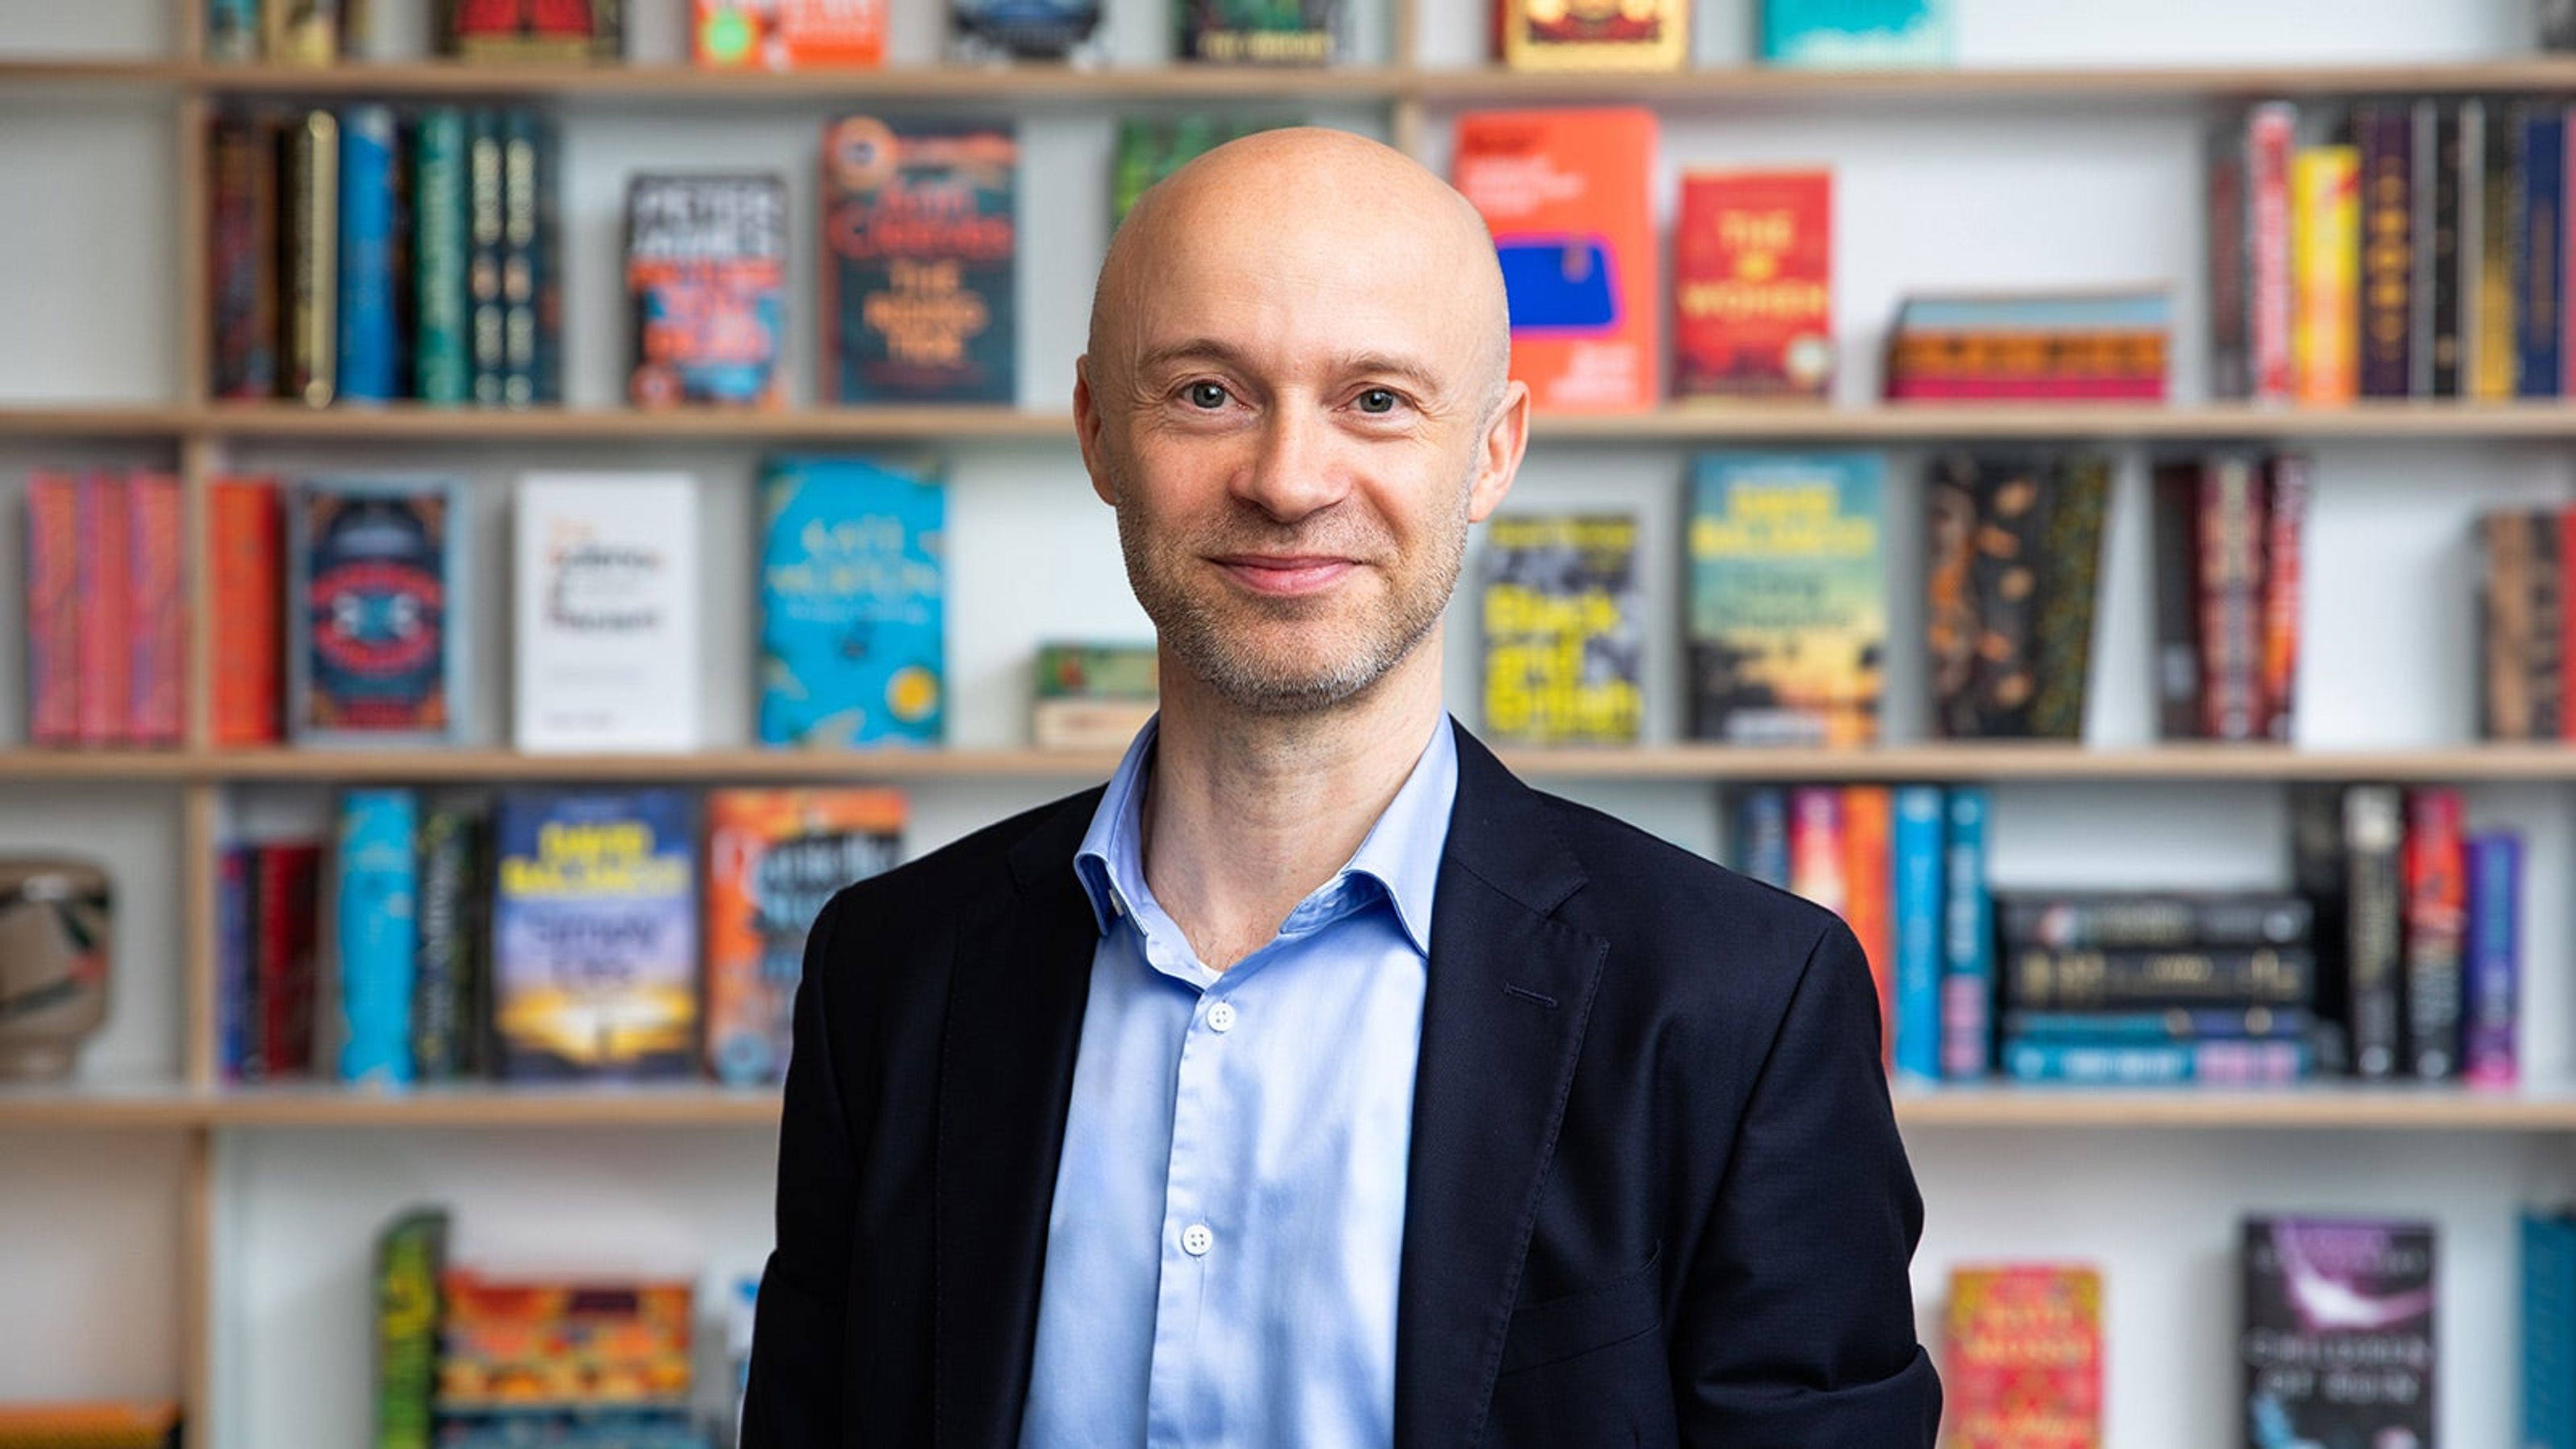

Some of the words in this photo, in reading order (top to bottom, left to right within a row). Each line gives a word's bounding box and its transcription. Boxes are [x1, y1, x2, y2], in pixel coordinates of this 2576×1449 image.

[636, 181, 782, 216] PETER
[633, 219, 782, 257] JAMES
[1717, 211, 1794, 248] THE
[889, 260, 962, 294] THE
[1682, 283, 1826, 319] WOMEN
[1484, 585, 1620, 634] Black
[1487, 634, 1582, 683] and
[1485, 682, 1644, 733] British
[539, 822, 653, 858] DAVID
[498, 859, 692, 896] BALDACCI
